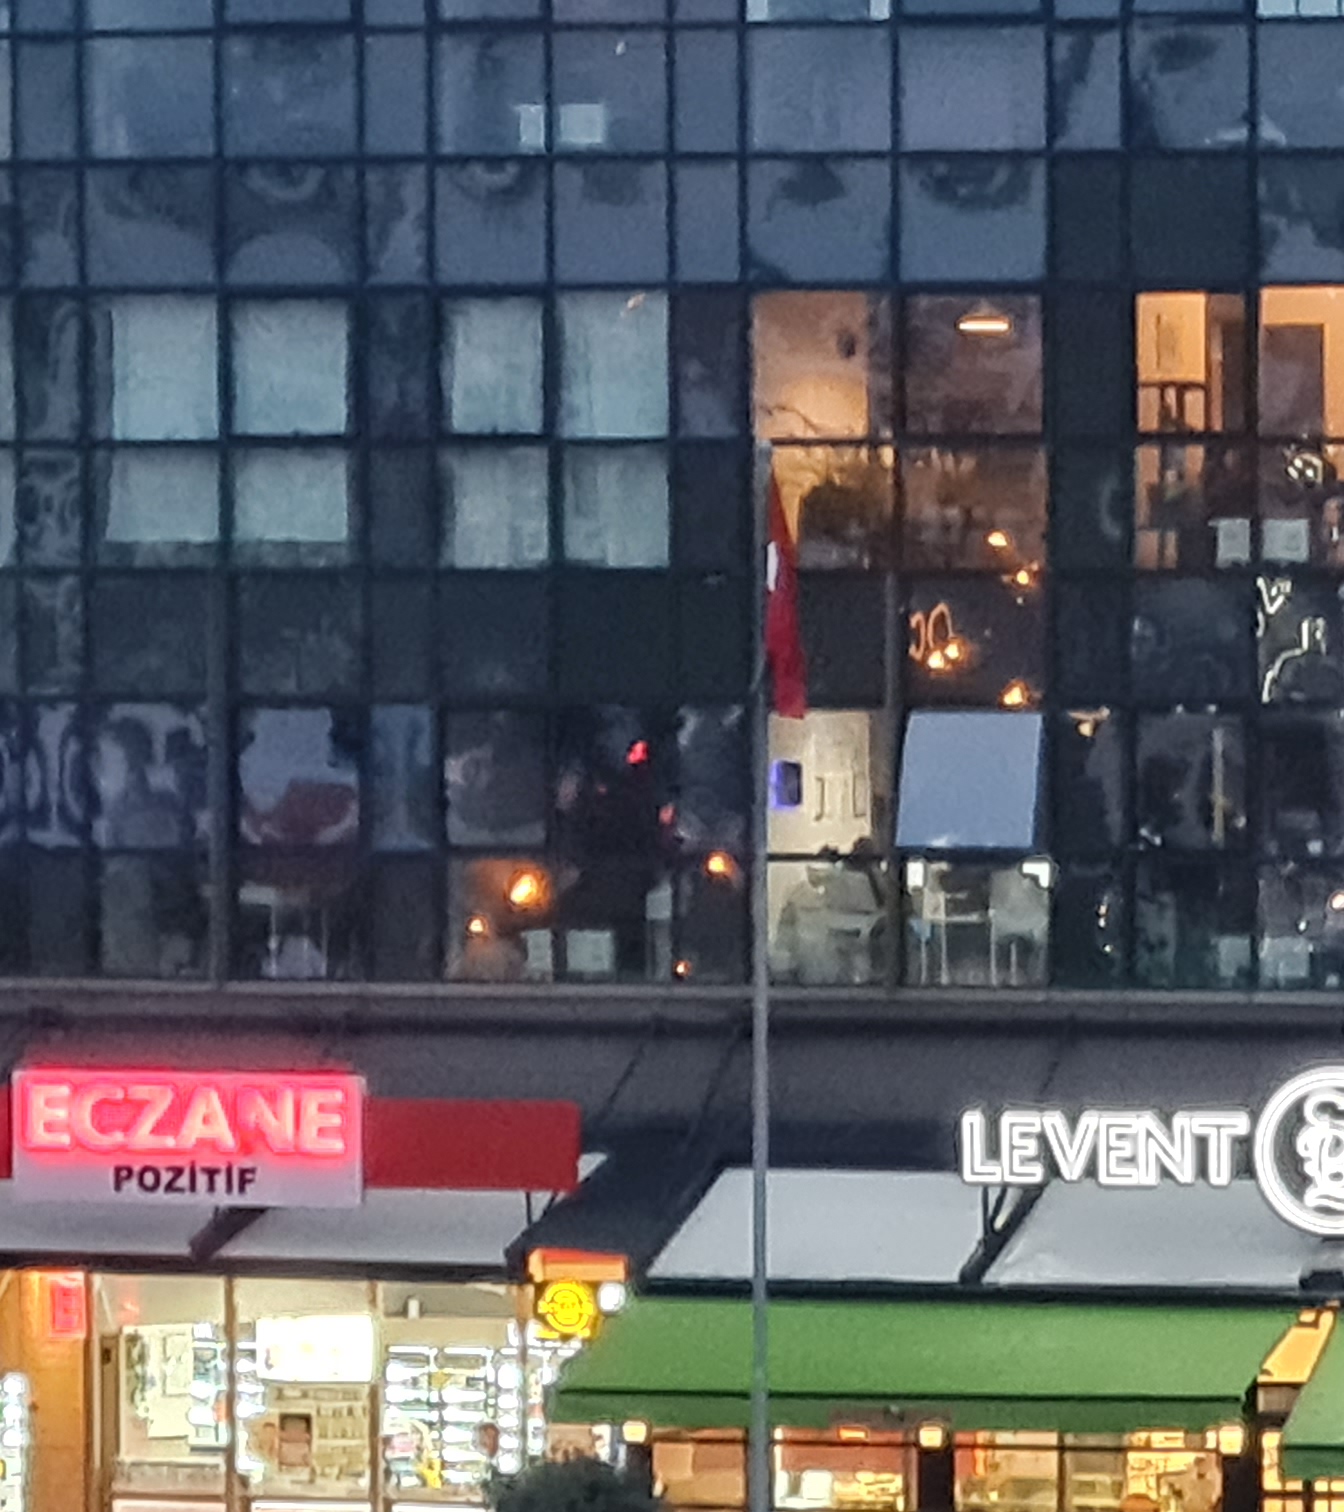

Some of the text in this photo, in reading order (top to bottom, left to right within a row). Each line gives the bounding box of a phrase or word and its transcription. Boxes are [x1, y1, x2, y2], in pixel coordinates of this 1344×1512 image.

[25, 1081, 346, 1155] ECZANE
[958, 1108, 1249, 1187] LEVENT
[113, 1160, 258, 1195] POZİTİF
